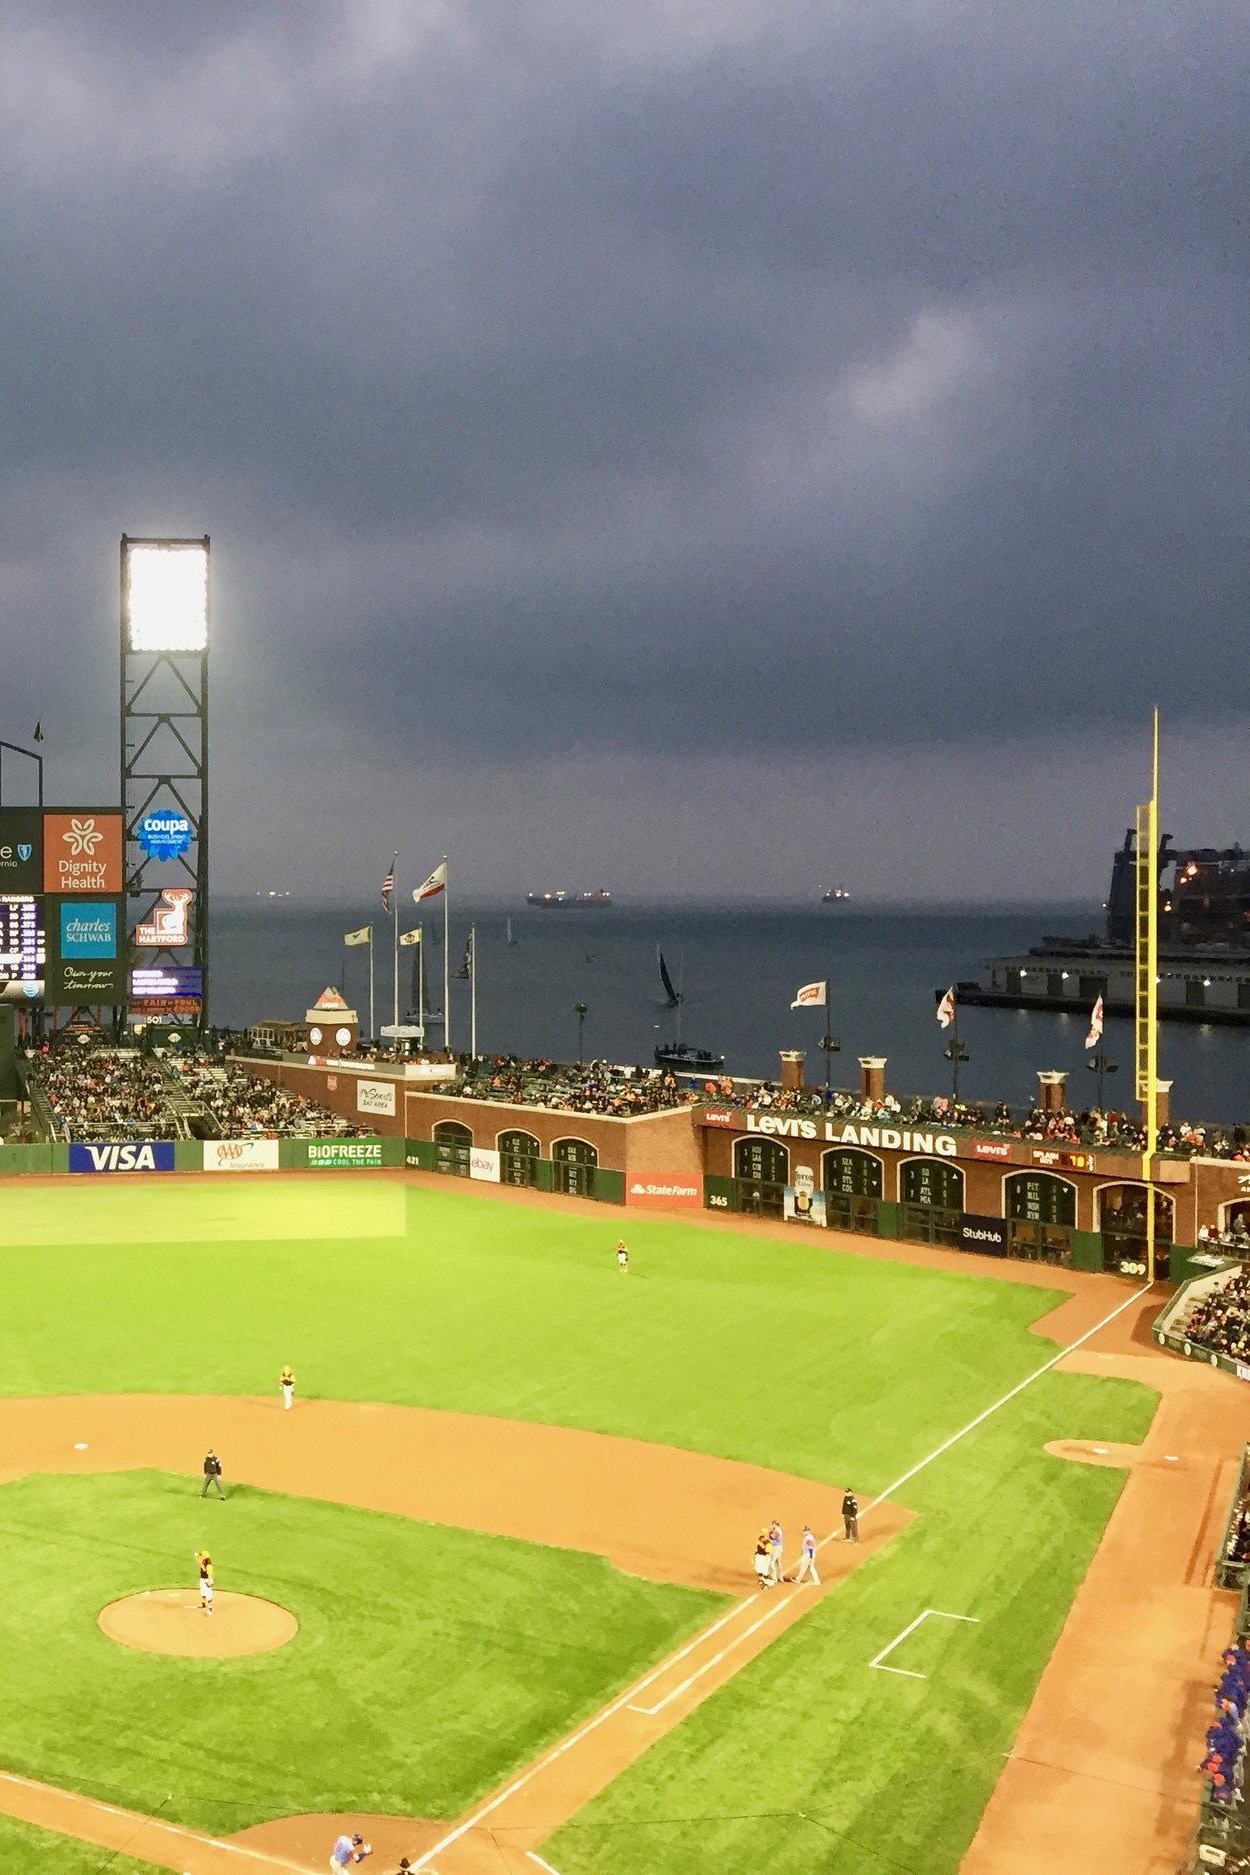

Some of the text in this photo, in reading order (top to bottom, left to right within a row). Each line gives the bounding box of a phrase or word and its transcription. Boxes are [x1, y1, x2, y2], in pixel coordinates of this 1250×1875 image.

[144, 819, 188, 834] coupa
[58, 860, 107, 875] Dignity
[61, 876, 105, 889] Health
[66, 918, 111, 931] charles
[139, 927, 157, 935] THE
[66, 933, 112, 942] SCHWAB
[139, 935, 184, 944] HARTFORD
[64, 966, 113, 982] Own your
[64, 981, 113, 990] tomorrow
[147, 1016, 162, 1024] 501
[825, 1122, 957, 1157] LANDING
[84, 1145, 156, 1170] VISA
[217, 1144, 243, 1160] AAA
[1033, 1150, 1059, 1160] SPLASH
[230, 1161, 265, 1169] Insurance
[406, 1156, 419, 1166] 421
[471, 1157, 494, 1172] ebay
[1027, 1182, 1039, 1191] PIT
[710, 1195, 727, 1207] 365
[963, 1227, 1002, 1243] StubHub
[1120, 1261, 1146, 1276] 309
